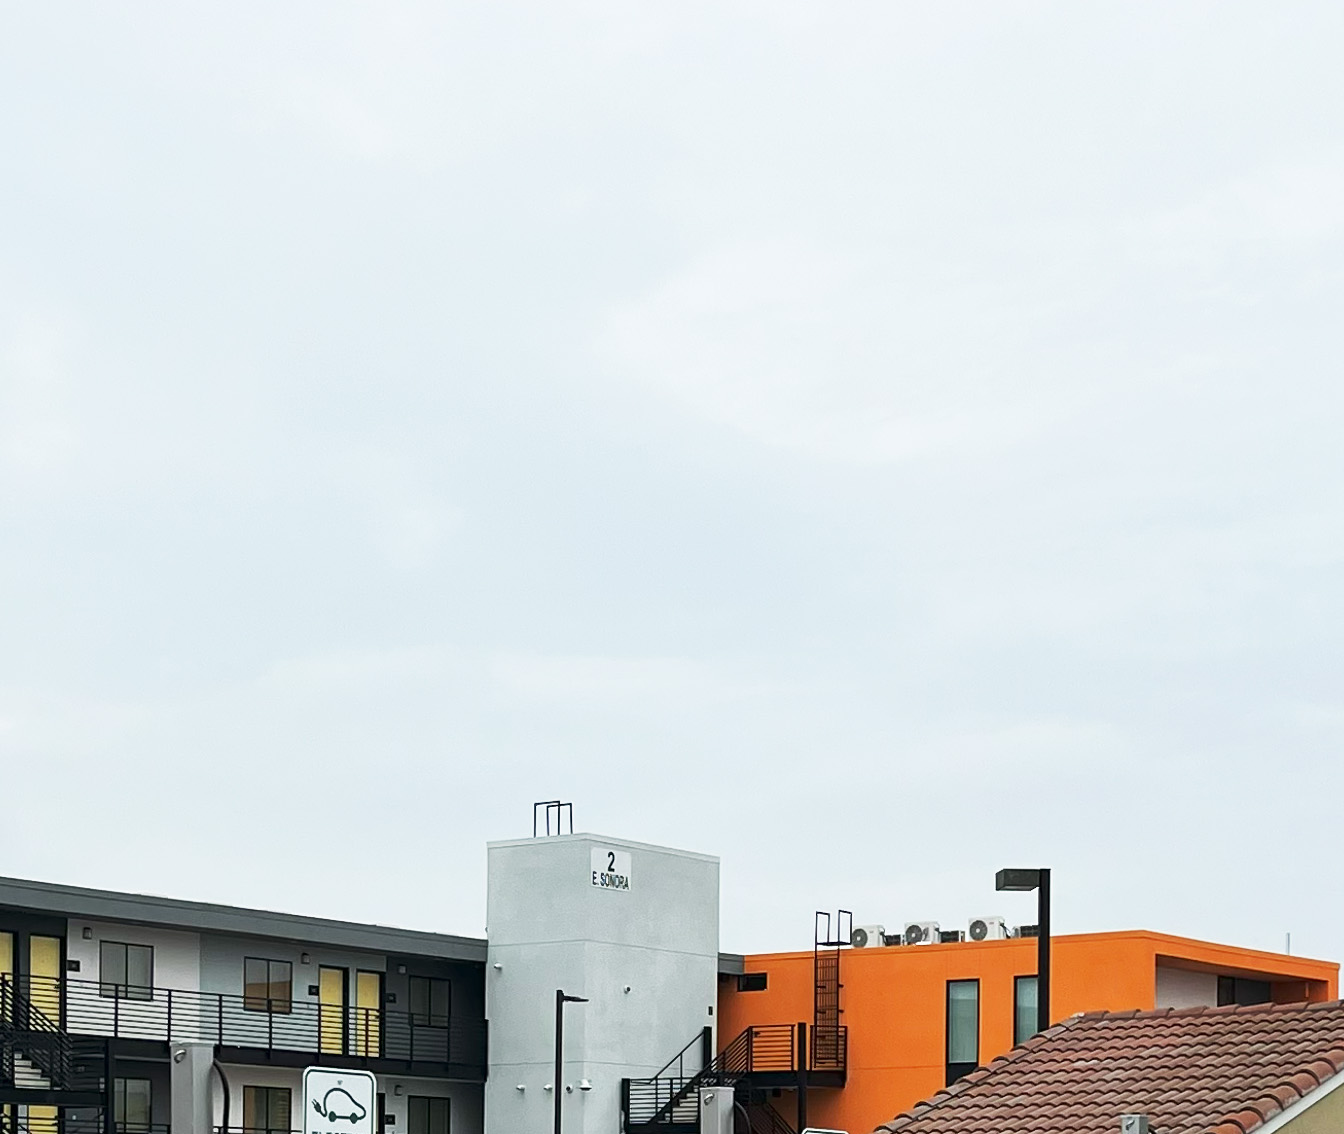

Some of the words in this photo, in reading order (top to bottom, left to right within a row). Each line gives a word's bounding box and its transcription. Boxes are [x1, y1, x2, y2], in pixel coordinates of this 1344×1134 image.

[607, 851, 616, 873] 2
[592, 870, 599, 886] E.
[600, 872, 630, 891] SONORA
